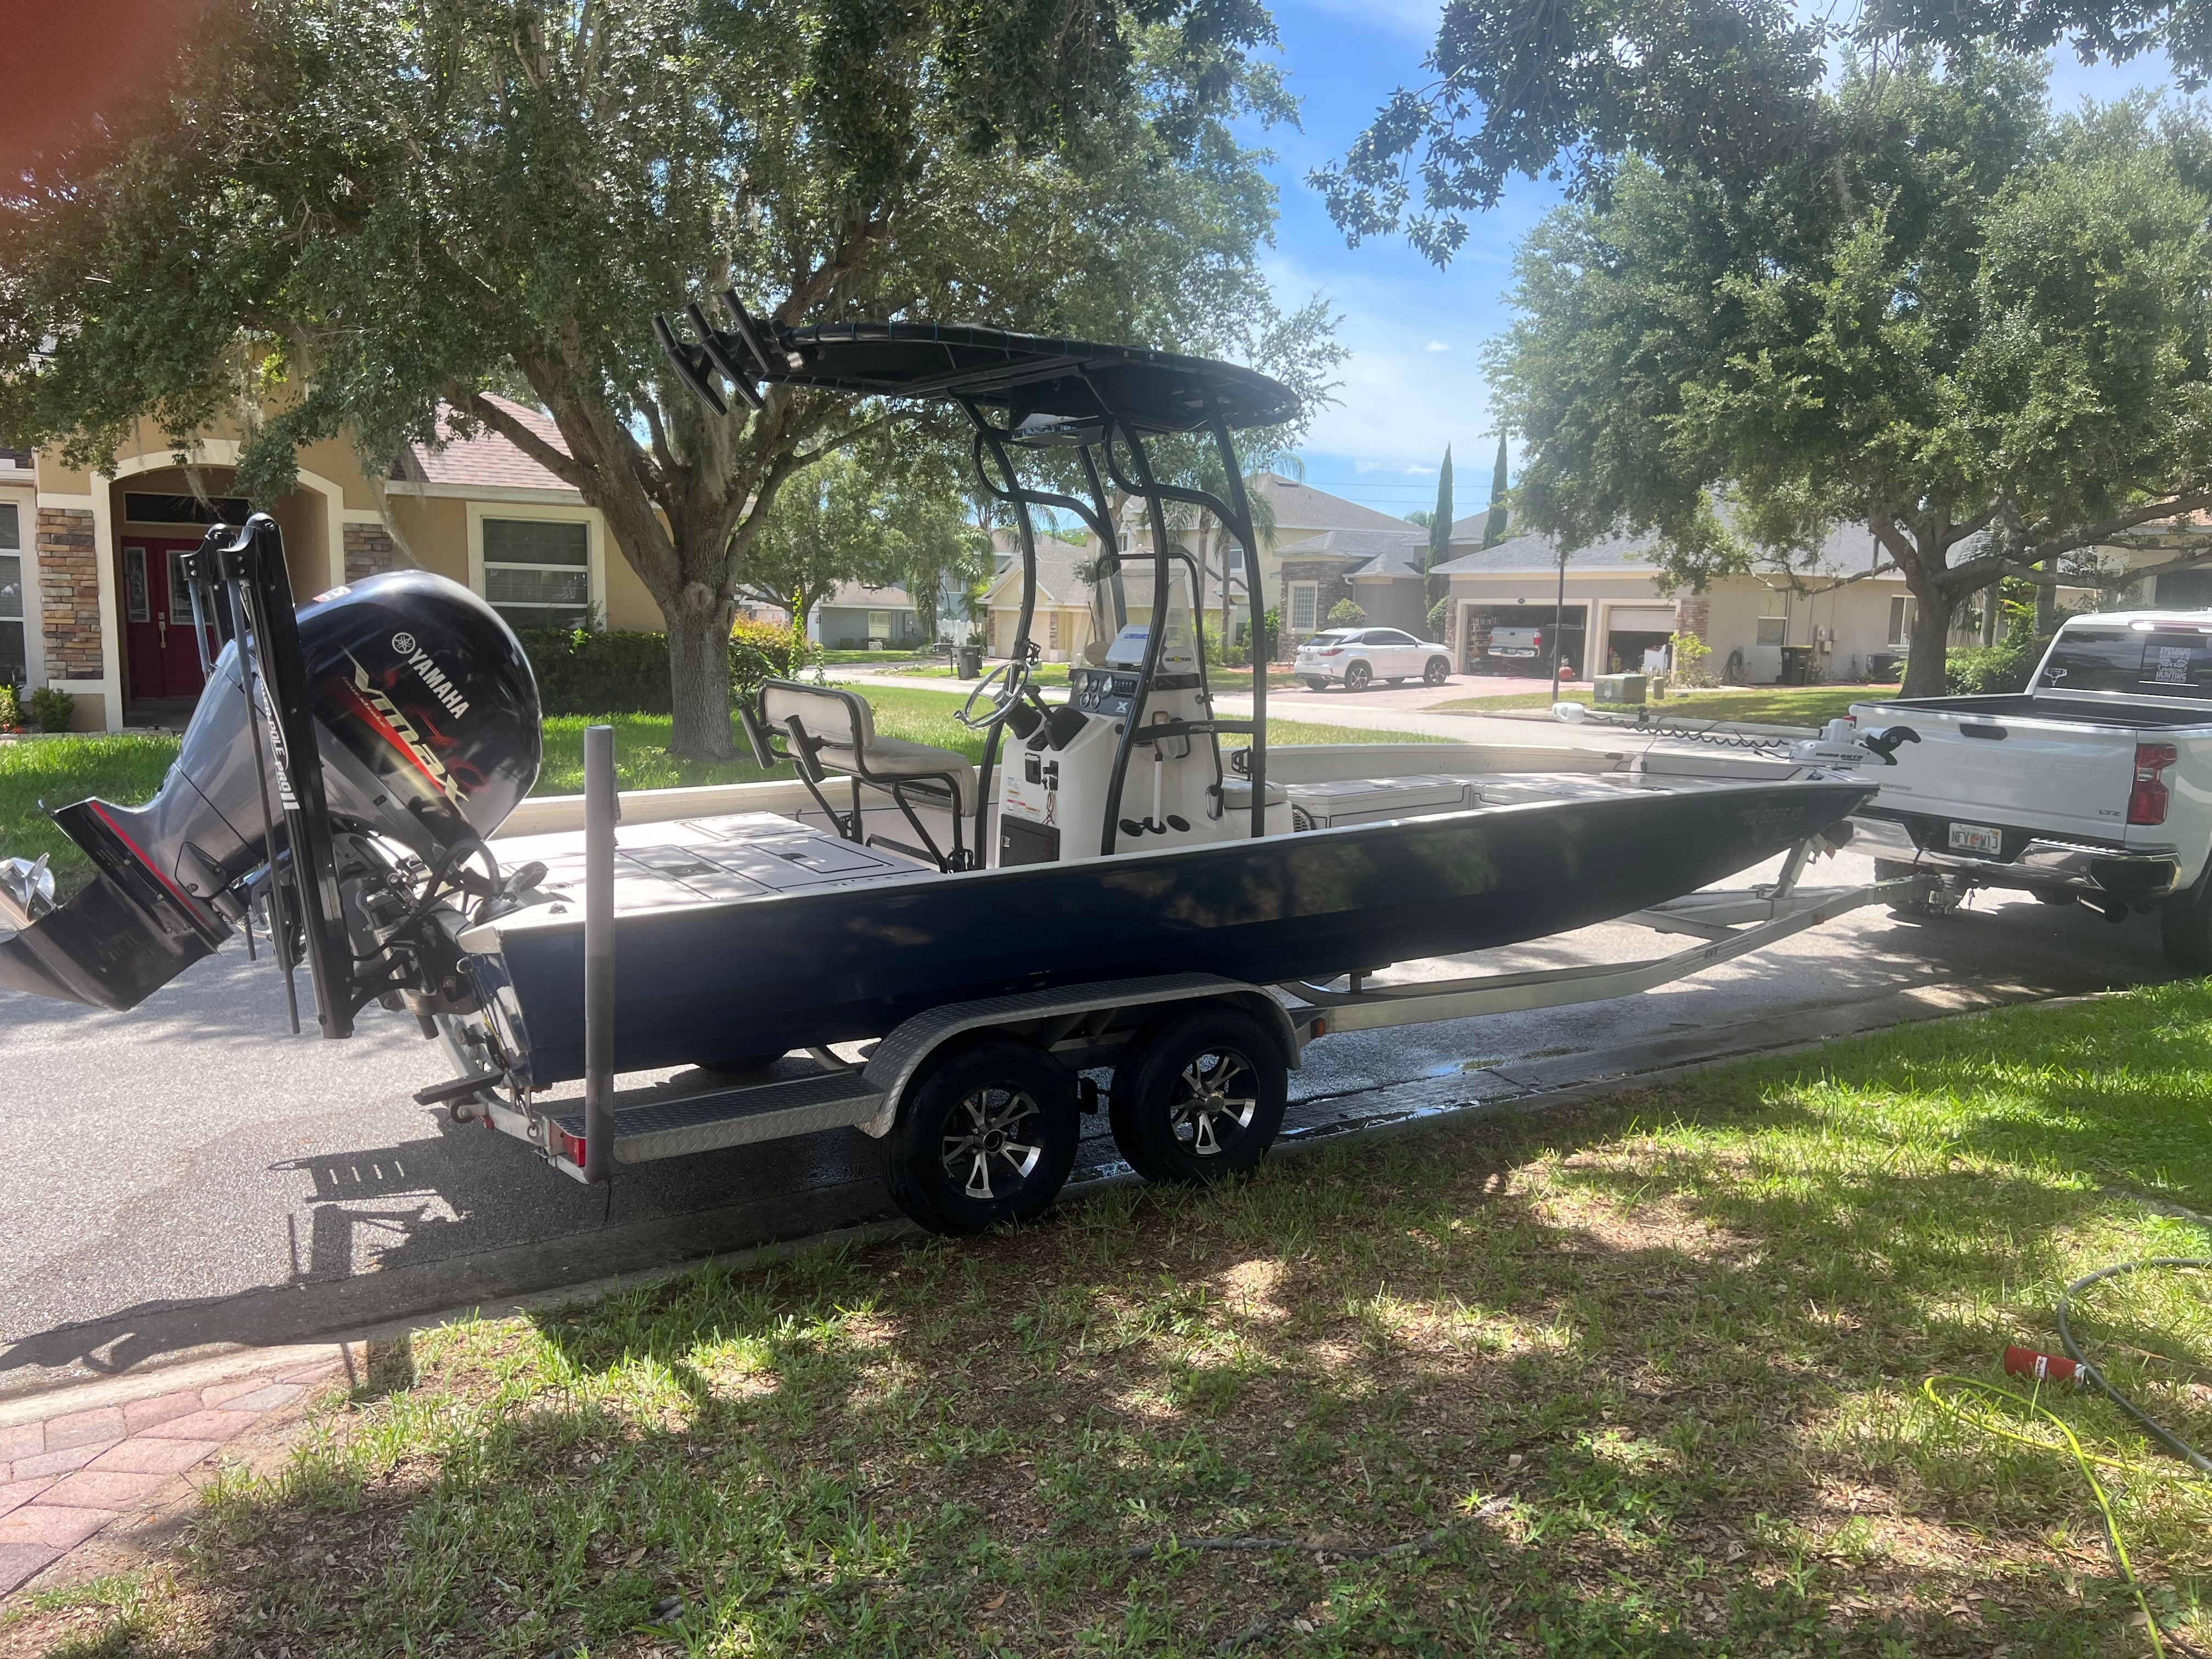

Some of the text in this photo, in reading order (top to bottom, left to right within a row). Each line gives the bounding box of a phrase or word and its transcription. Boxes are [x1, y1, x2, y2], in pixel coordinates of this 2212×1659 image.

[2160, 647, 2191, 657] FISHING
[2156, 671, 2187, 680] HUNTING
[408, 648, 470, 719] YAMAHA
[275, 761, 292, 792] PRO
[1703, 946, 1721, 958] BT
